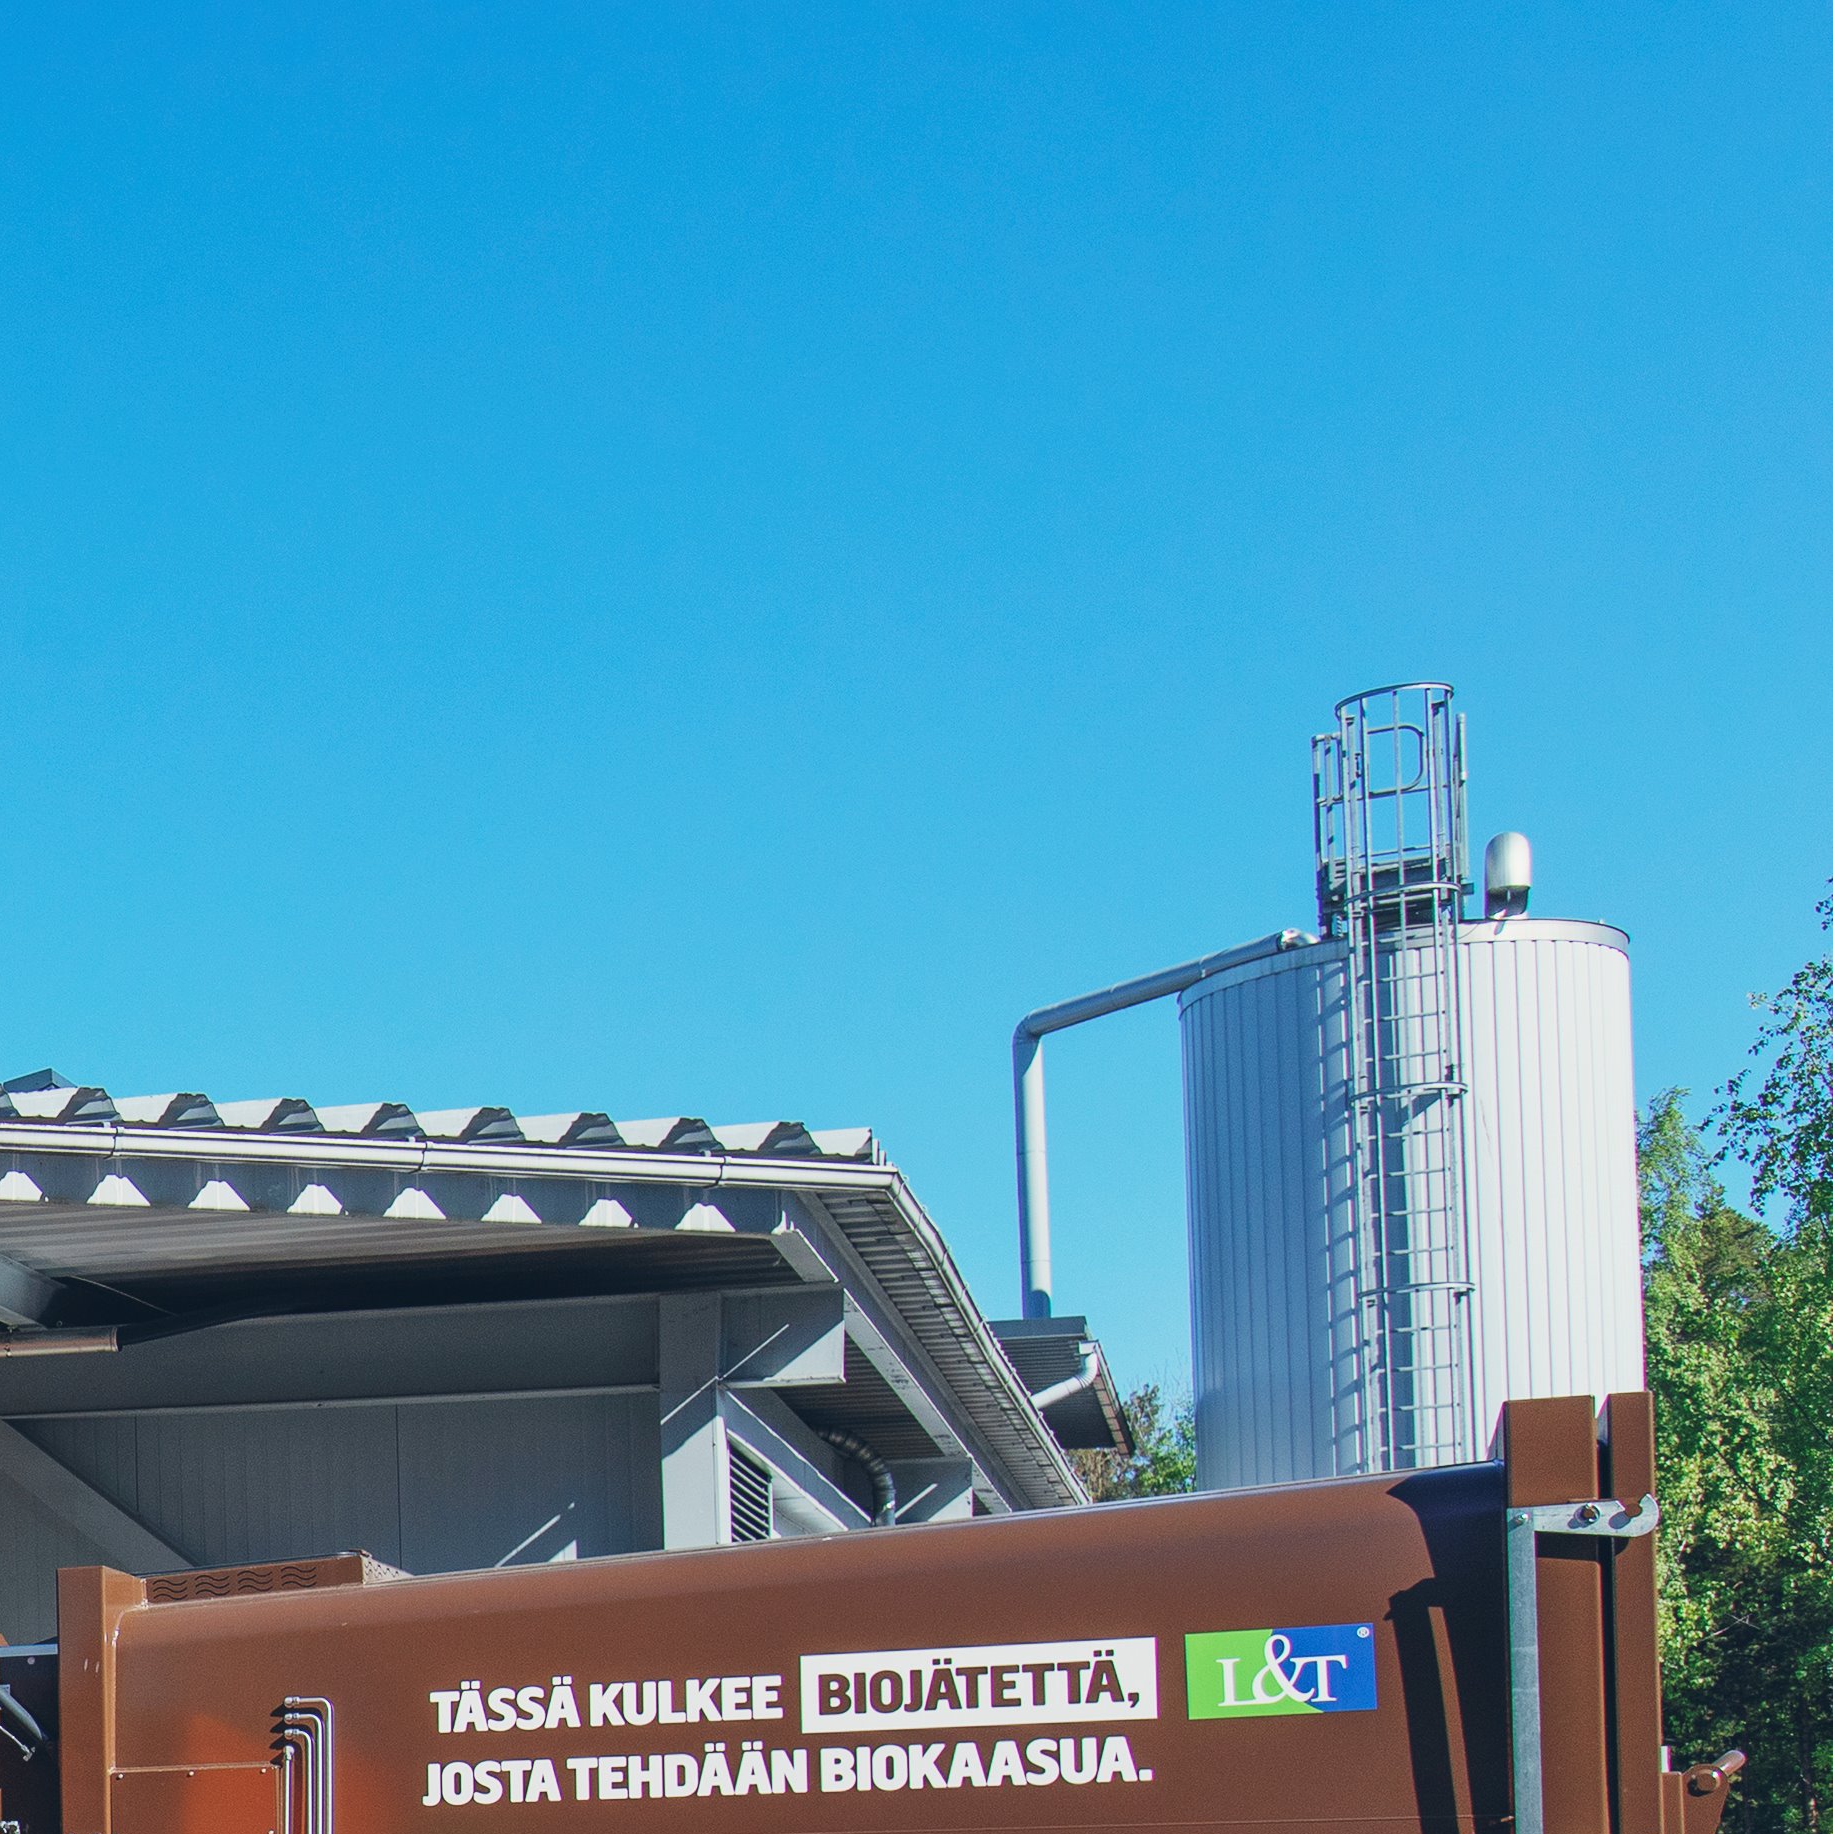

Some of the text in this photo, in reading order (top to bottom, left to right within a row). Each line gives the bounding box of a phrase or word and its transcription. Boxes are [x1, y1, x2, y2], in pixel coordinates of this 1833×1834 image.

[429, 1648, 1140, 1734] TÄSSÄ KULKEE BIOJÄTETTÄ,
[1215, 1633, 1349, 1708] L&T
[422, 1735, 1153, 1807] JOSTA TEHDÄÄN BIOKAASUA.
